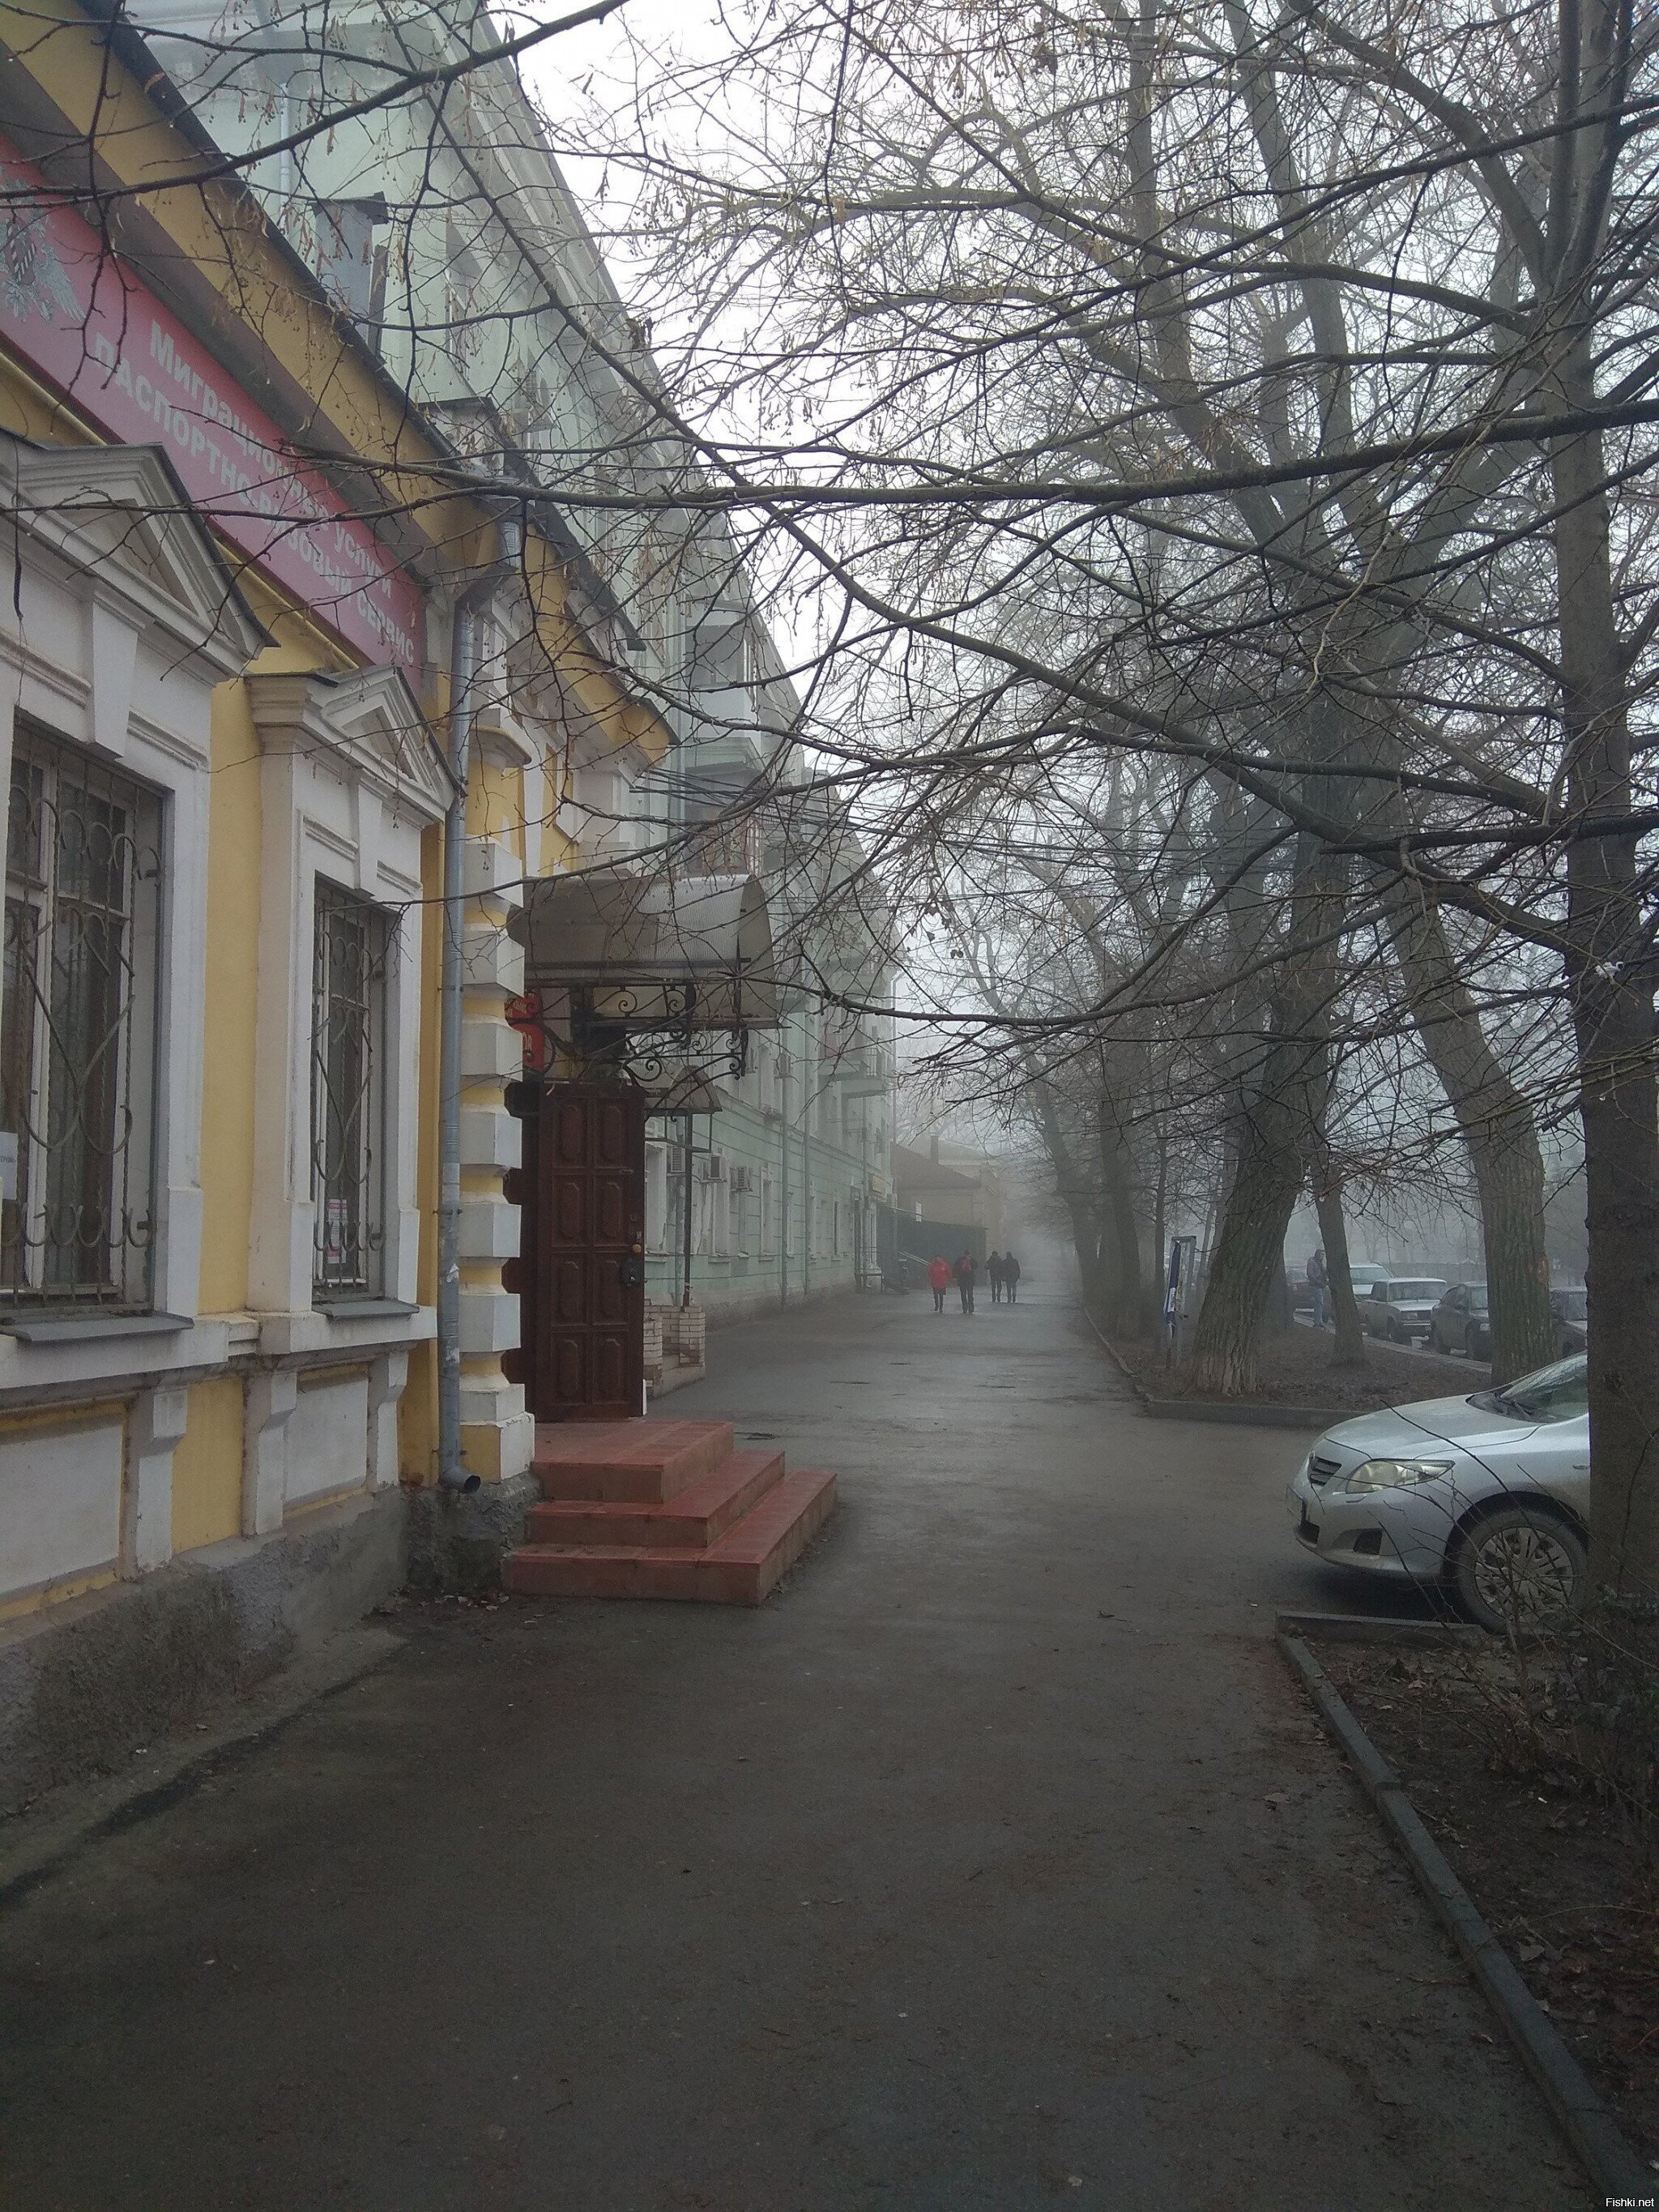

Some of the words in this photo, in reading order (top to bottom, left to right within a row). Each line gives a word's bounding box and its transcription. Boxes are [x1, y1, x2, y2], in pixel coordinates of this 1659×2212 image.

[150, 319, 330, 532] Миграционные
[335, 521, 393, 600] услуги
[356, 589, 415, 664] СЕРВИС
